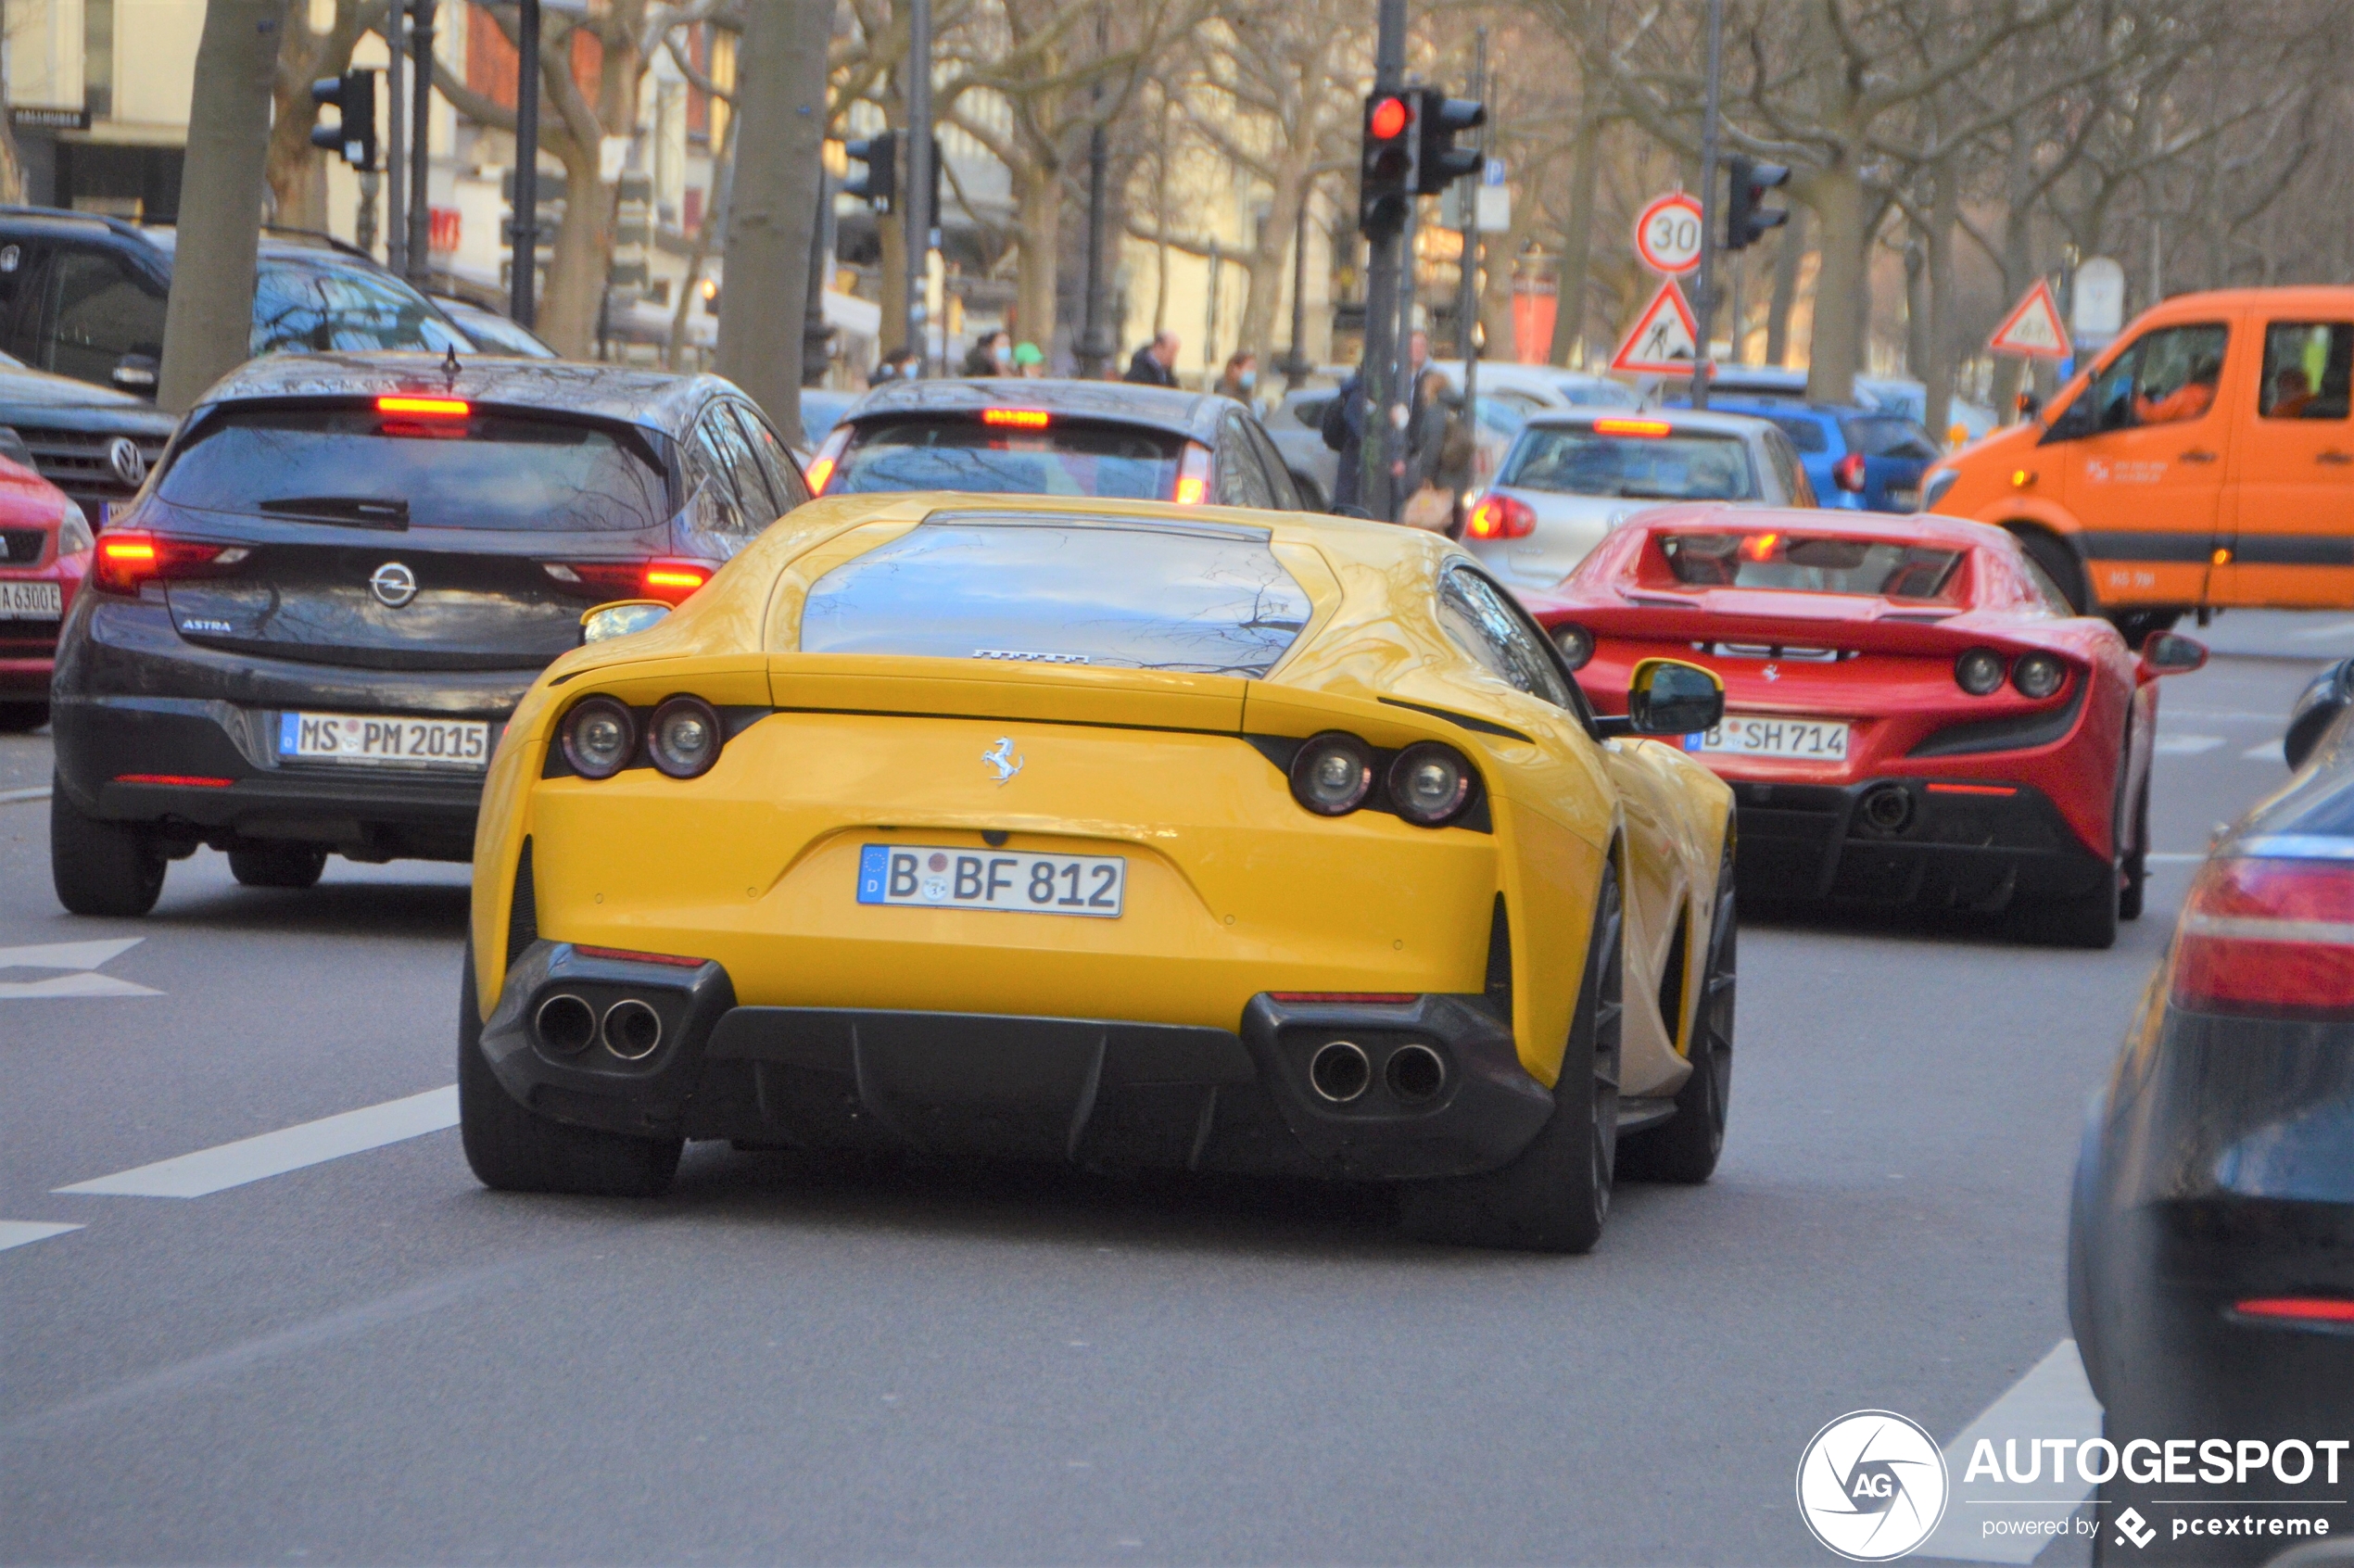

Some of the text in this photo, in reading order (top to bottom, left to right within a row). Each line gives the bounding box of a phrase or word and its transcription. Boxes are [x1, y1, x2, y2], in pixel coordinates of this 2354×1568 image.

[1654, 217, 1697, 252] 30
[183, 619, 231, 632] ASTRA
[973, 649, 1090, 664] Ferrari
[300, 719, 338, 752] MS
[363, 723, 402, 754] PM
[409, 725, 483, 758] 2015
[1745, 723, 1783, 751] SH
[1791, 726, 1843, 754] 714
[867, 854, 1118, 907] D B BF 812
